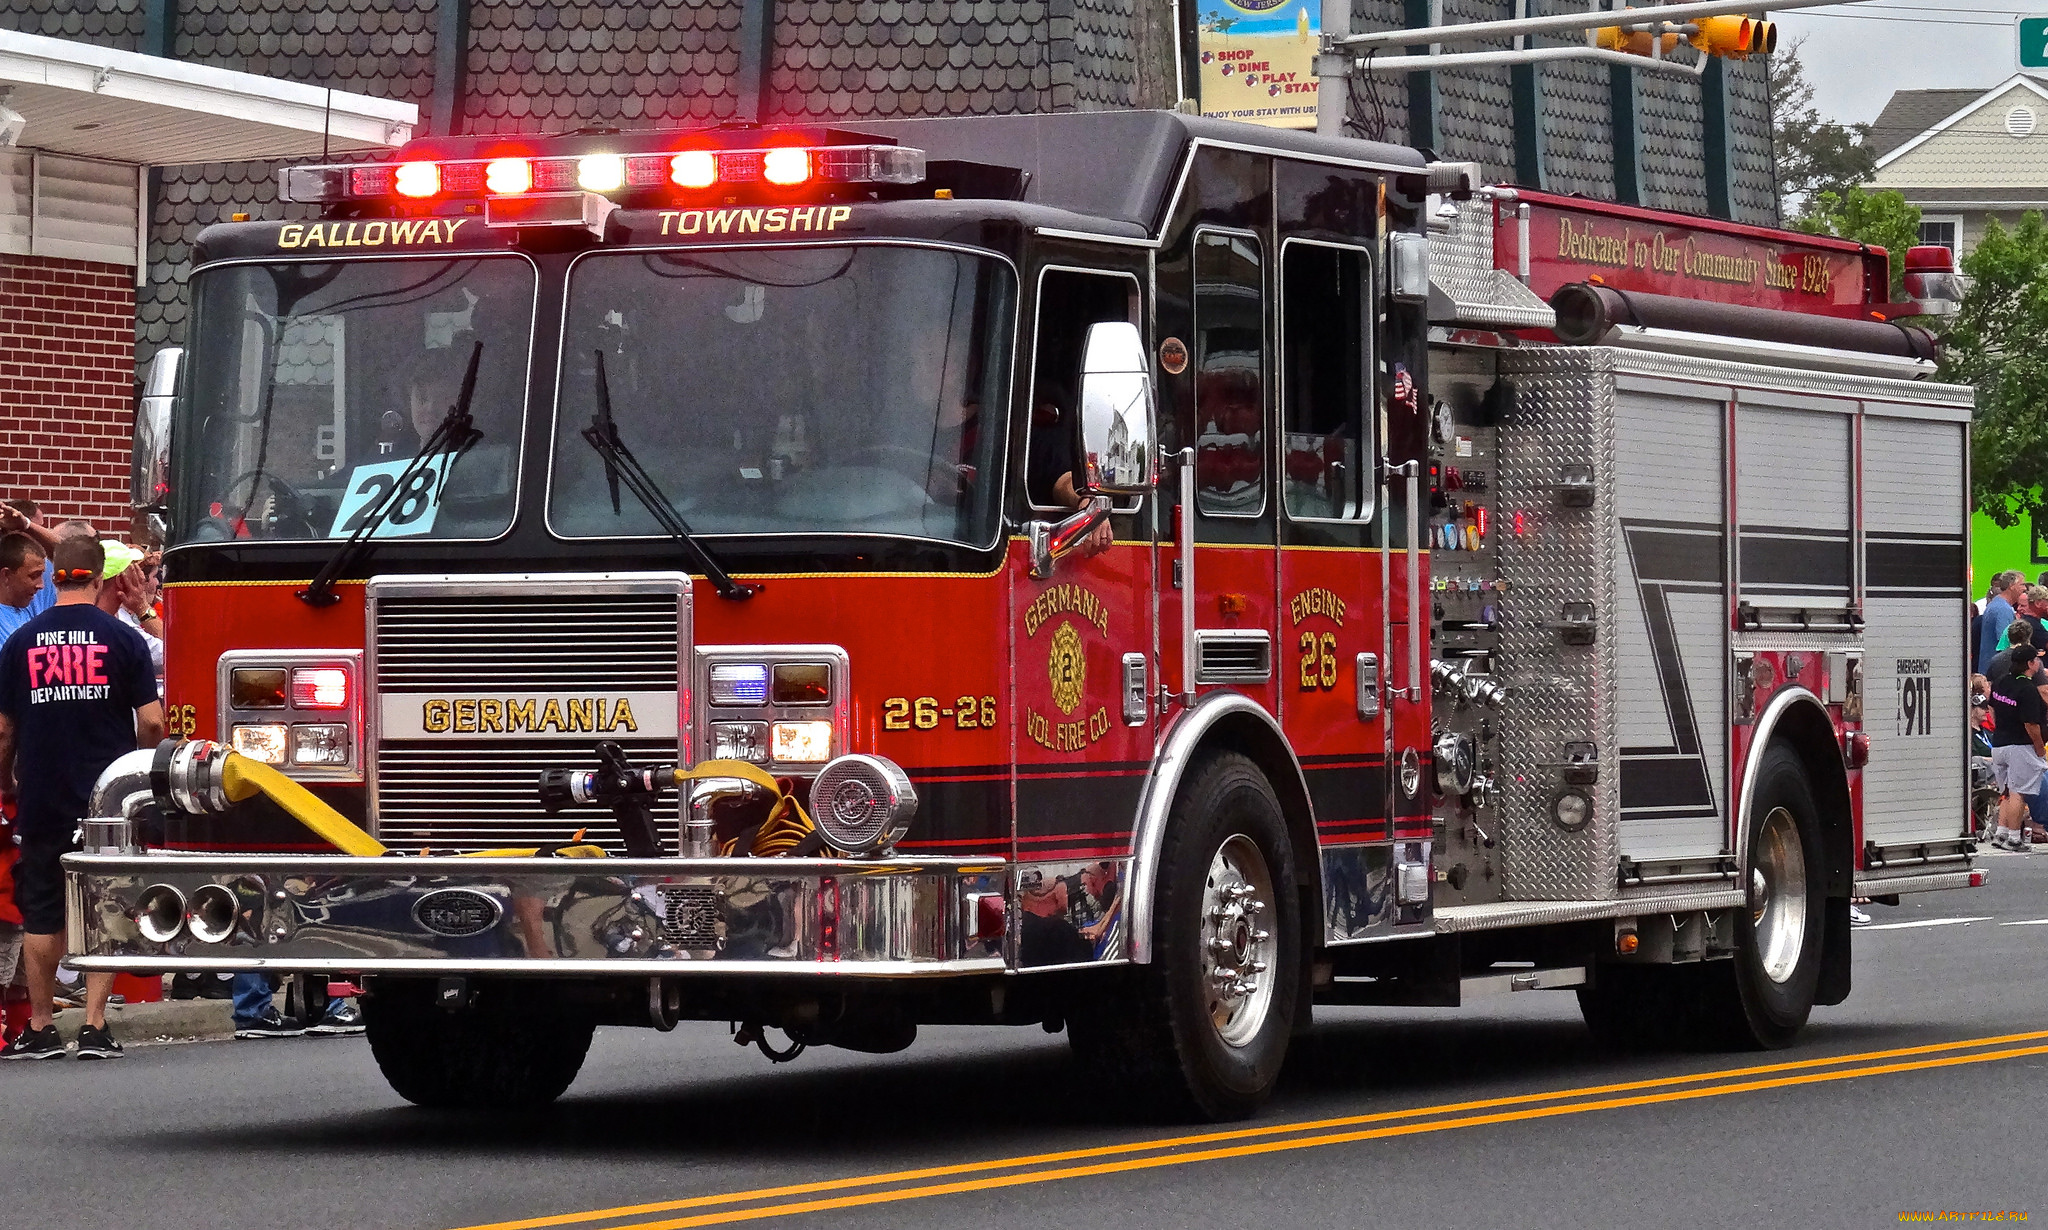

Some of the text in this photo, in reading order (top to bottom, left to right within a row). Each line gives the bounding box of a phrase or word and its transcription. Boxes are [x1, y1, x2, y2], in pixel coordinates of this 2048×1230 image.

[1218, 50, 1254, 61] SHOP
[1238, 62, 1270, 73] DINE
[1262, 72, 1297, 83] PLAY
[1284, 82, 1319, 94] STAY
[1203, 105, 1317, 119] ENJOY YOUR STAY WITH US!
[277, 219, 467, 249] GALLOWAY
[658, 206, 852, 236] TOWNSHIP
[1558, 217, 1831, 294] Dedicated to Our Community Since 1926
[340, 467, 437, 533] 28
[1024, 583, 1109, 638] GERMANIA
[1290, 587, 1347, 628] ENGINE
[36, 631, 98, 646] PINE HILL
[1062, 653, 1072, 682] 2
[1300, 631, 1337, 690] 26
[1897, 659, 1931, 674] EMERGENCY
[31, 685, 111, 705] DEPARTMENT
[1903, 677, 1931, 736] 911
[423, 698, 638, 733] GERMANIA
[883, 695, 997, 731] 26-26
[1056, 719, 1087, 751] FIRE
[1089, 706, 1112, 742] CO.
